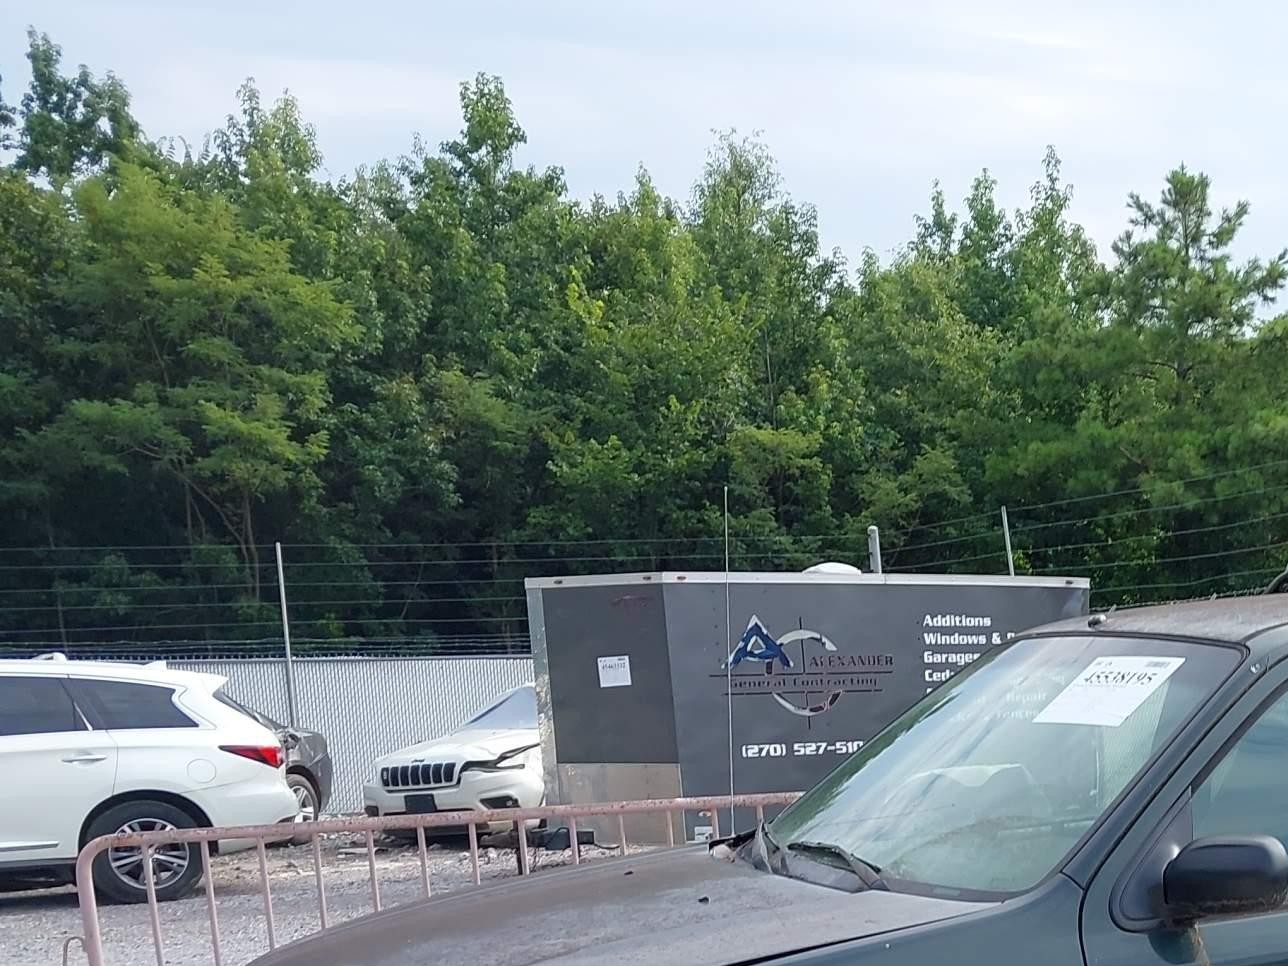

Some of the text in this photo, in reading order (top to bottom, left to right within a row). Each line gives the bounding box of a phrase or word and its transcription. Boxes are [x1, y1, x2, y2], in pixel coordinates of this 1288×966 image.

[923, 614, 991, 627] Additions
[923, 632, 987, 645] Windows
[991, 632, 1002, 645] &
[810, 655, 894, 667] ALEXANDER
[793, 677, 878, 689] Contracting
[742, 743, 787, 758] (270)
